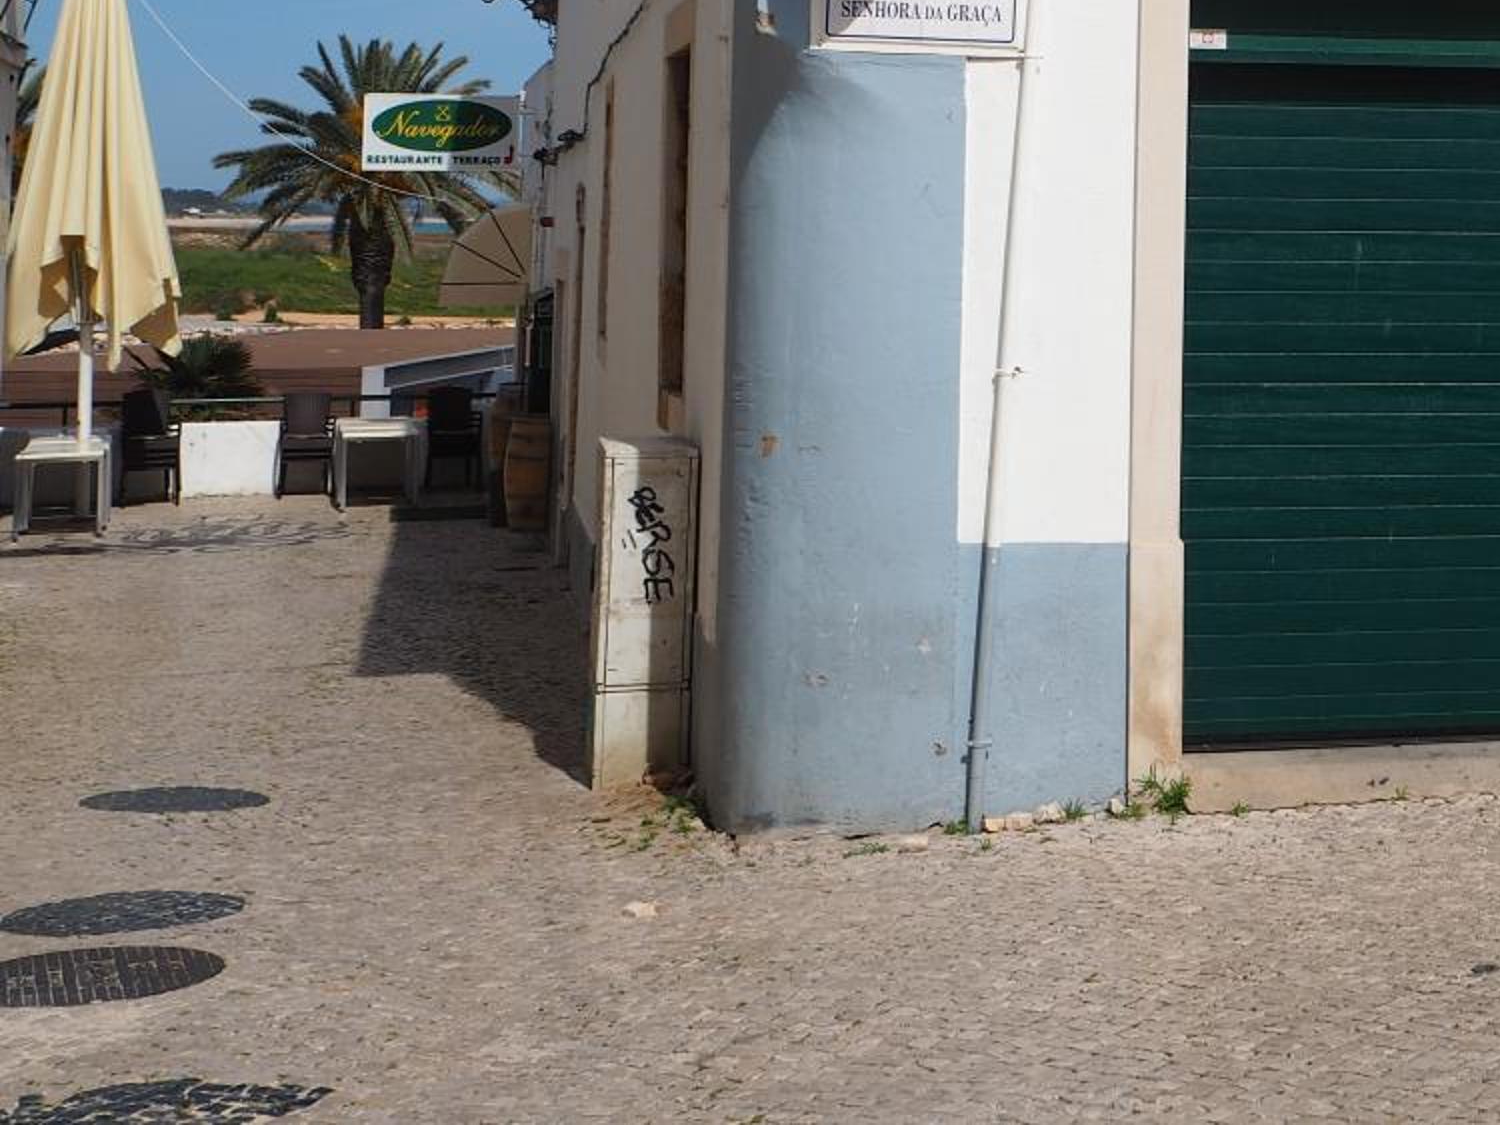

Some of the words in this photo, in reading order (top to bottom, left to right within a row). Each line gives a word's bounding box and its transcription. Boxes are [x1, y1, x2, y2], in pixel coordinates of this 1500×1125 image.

[840, 0, 921, 22] SENHORA
[924, 5, 944, 20] DA
[947, 3, 1002, 26] GRAÇA
[366, 154, 443, 165] RESTAURANTE
